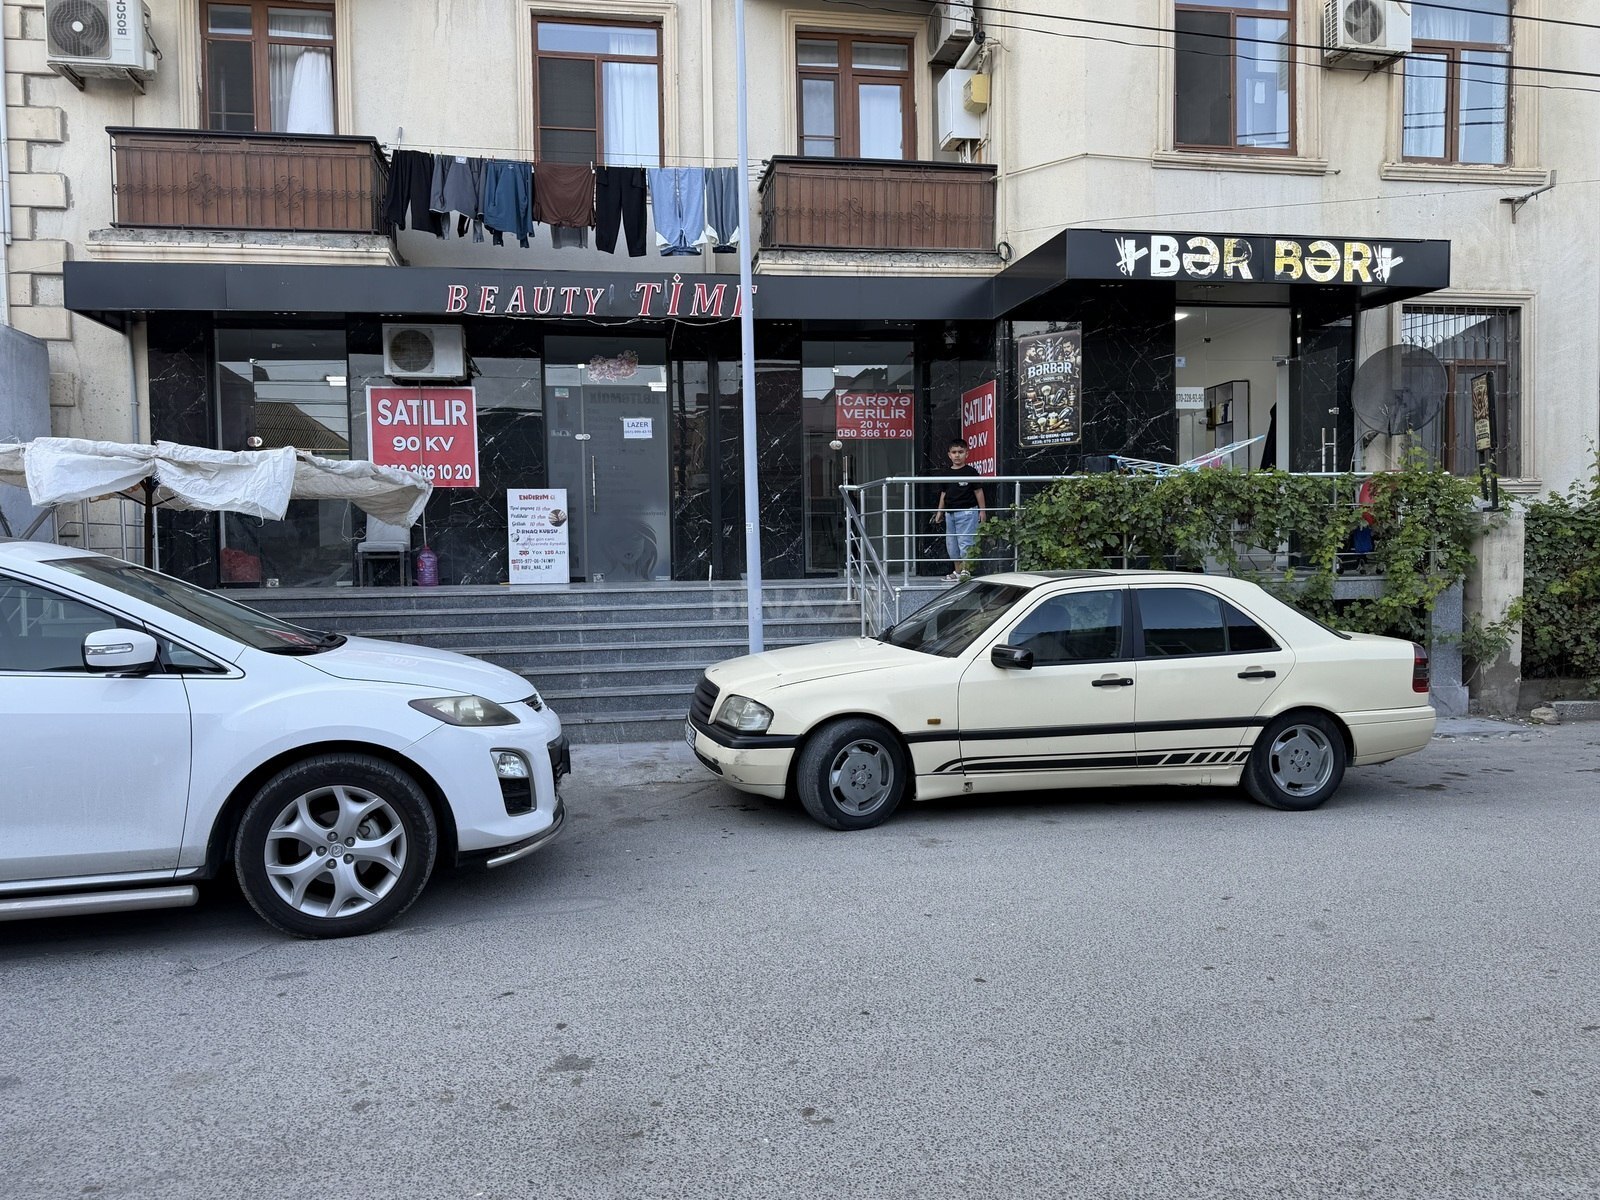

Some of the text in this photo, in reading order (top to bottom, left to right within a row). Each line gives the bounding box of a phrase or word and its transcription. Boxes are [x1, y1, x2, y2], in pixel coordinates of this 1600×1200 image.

[1150, 235, 1373, 283] BƏR BƏR
[445, 284, 605, 314] BEAUTY
[377, 398, 468, 426] SATILIR
[843, 407, 906, 419] VERİLİR
[964, 393, 993, 427] SATILIR
[876, 420, 889, 428] kv
[837, 429, 912, 437] 050 366 10 20
[968, 431, 988, 450] 90 KV
[392, 436, 454, 451] 90 KV
[438, 464, 452, 479] 10
[455, 464, 471, 479] 20
[988, 457, 994, 473] 20
